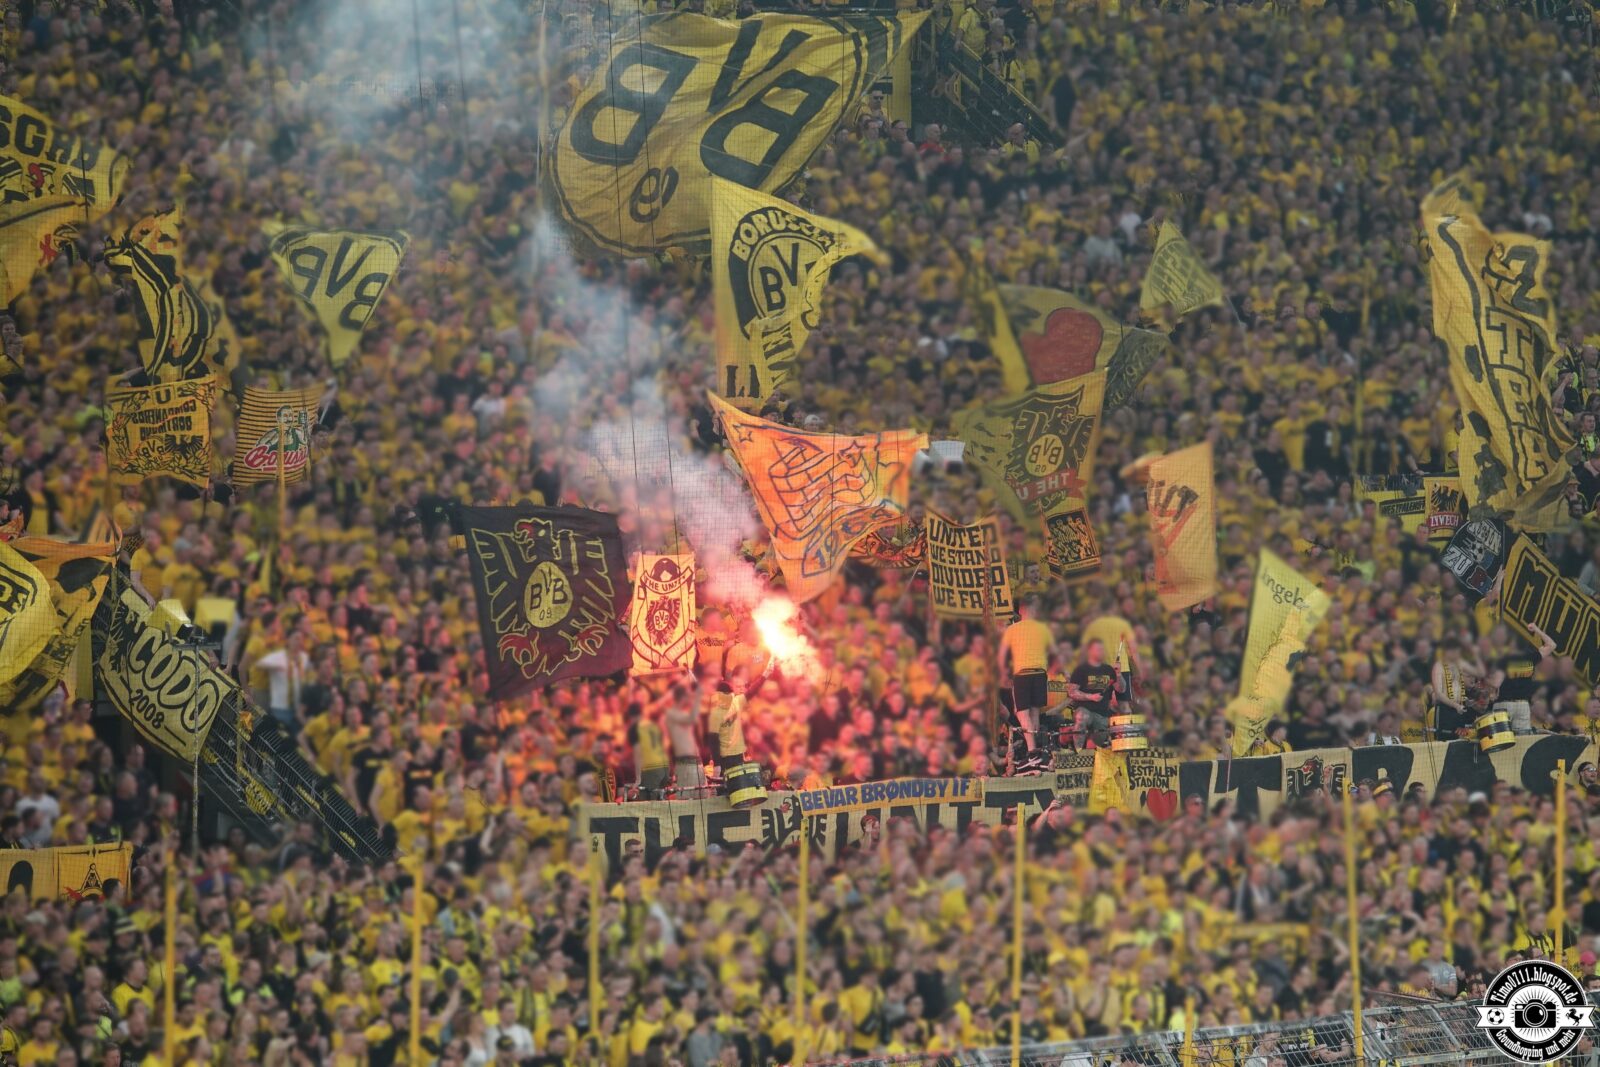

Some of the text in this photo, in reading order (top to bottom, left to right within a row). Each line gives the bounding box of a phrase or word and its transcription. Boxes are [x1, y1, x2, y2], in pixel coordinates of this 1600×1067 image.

[758, 242, 817, 312] BV
[155, 388, 171, 404] U
[930, 519, 997, 549] UNITED
[930, 542, 946, 564] WE
[530, 567, 568, 610] BVB
[931, 562, 1006, 589] DIVIDED
[934, 585, 1010, 609] WE FAL
[131, 688, 165, 730] 2008
[801, 778, 969, 812] BEVAR BRØNDBY IF
